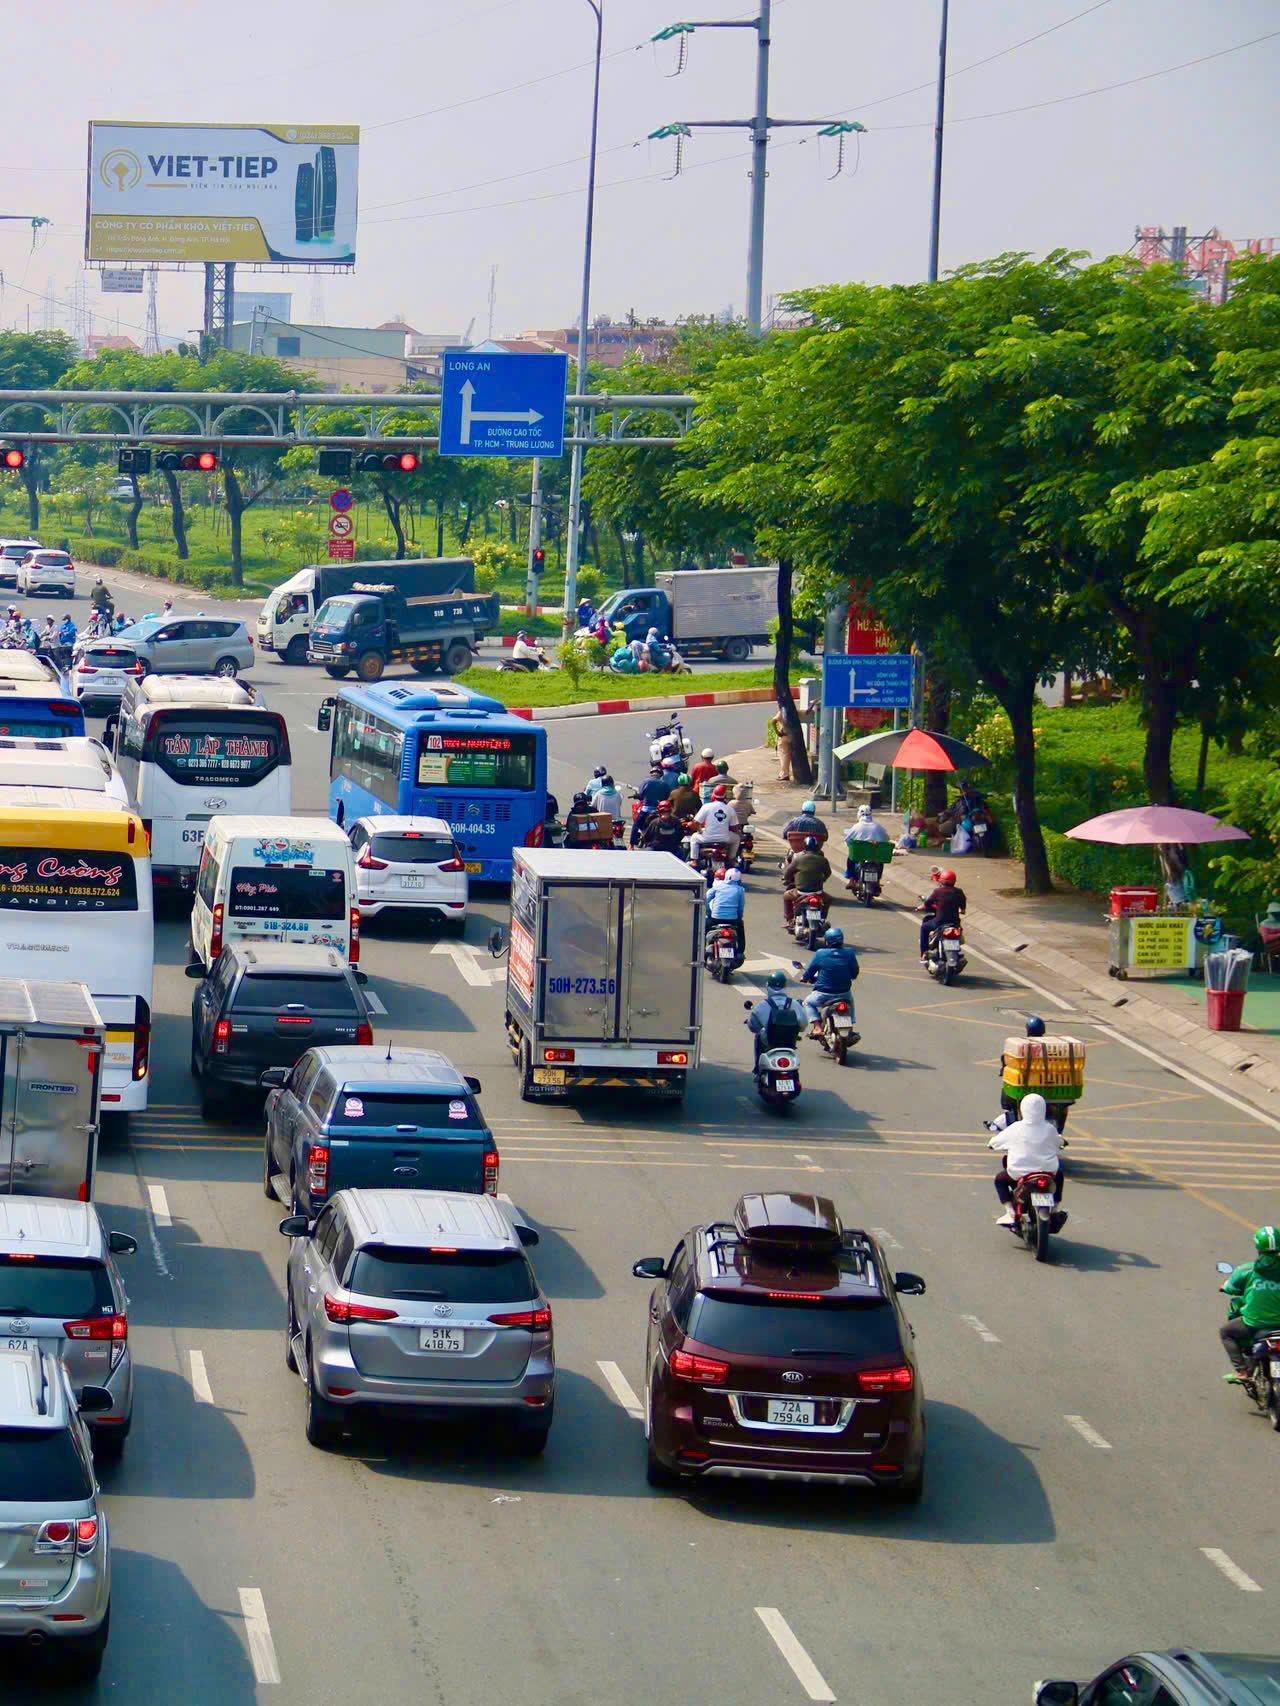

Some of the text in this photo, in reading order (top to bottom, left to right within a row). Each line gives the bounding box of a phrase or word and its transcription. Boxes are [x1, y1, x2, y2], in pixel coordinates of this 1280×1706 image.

[148, 155, 278, 178] VIET-TIEP
[449, 362, 491, 371] LONG AN
[487, 426, 542, 437] ĐƯỜNG CAO TỐC
[484, 440, 500, 448] HCM
[506, 440, 529, 448] TRUNG
[531, 440, 555, 449] LƯƠNG
[165, 734, 191, 755] TÂN
[225, 736, 269, 757] THÀNH
[430, 737, 441, 748] 102
[451, 823, 495, 834] 50H-404.35
[549, 977, 615, 995] 50H-273.56
[30, 1084, 74, 1092] FRONTIER
[1253, 1280, 1280, 1291] Gra
[432, 1329, 452, 1339] 51K
[8, 1340, 28, 1351] 62A
[424, 1339, 460, 1350] 418.75
[781, 1401, 801, 1413] 72A
[773, 1412, 809, 1424] 759.48
